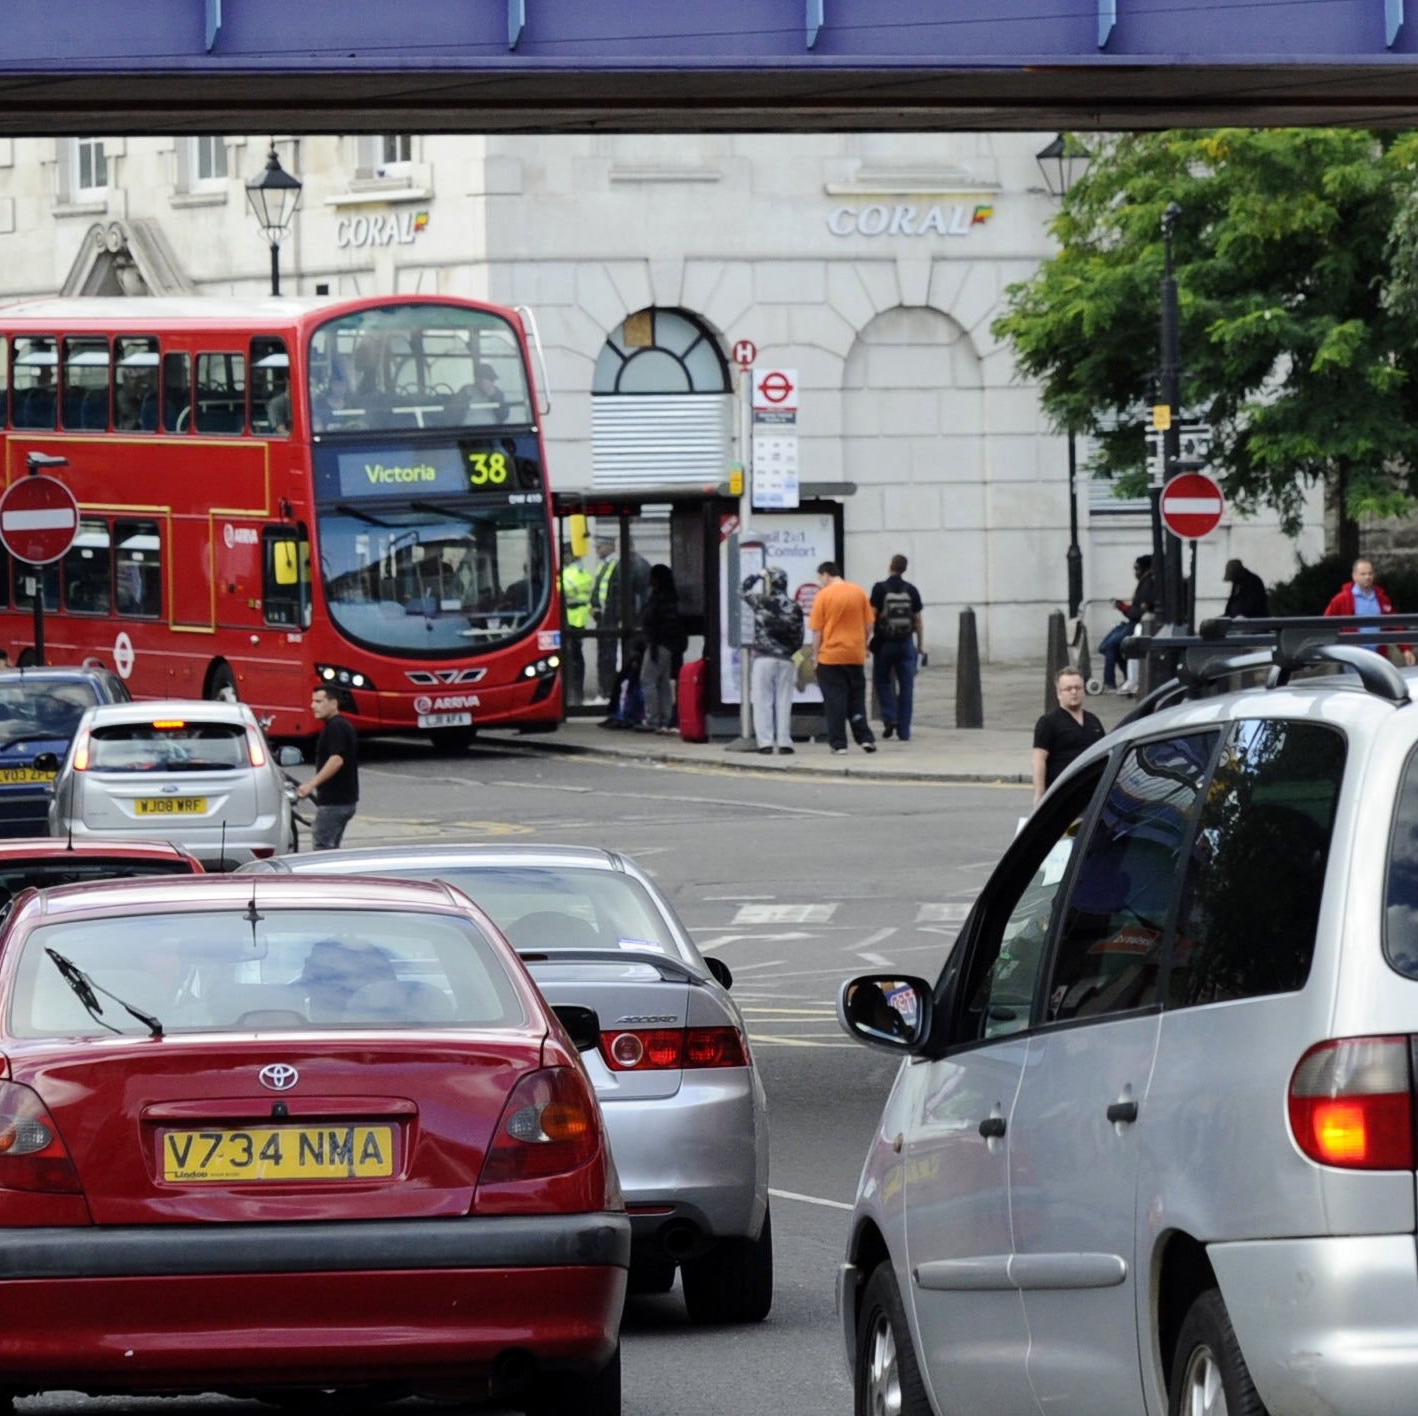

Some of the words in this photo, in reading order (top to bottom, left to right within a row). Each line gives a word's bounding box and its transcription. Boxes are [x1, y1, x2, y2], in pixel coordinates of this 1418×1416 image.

[338, 212, 416, 249] CORAL
[827, 204, 972, 238] CORAL
[365, 464, 436, 484] Victoria
[469, 452, 508, 485] 38
[434, 694, 480, 710] ARRIVA
[141, 798, 172, 814] WJ08
[178, 797, 201, 812] WRF
[615, 1015, 678, 1024] ACCORD
[168, 1132, 283, 1169] V734
[298, 1130, 384, 1167] NMA
